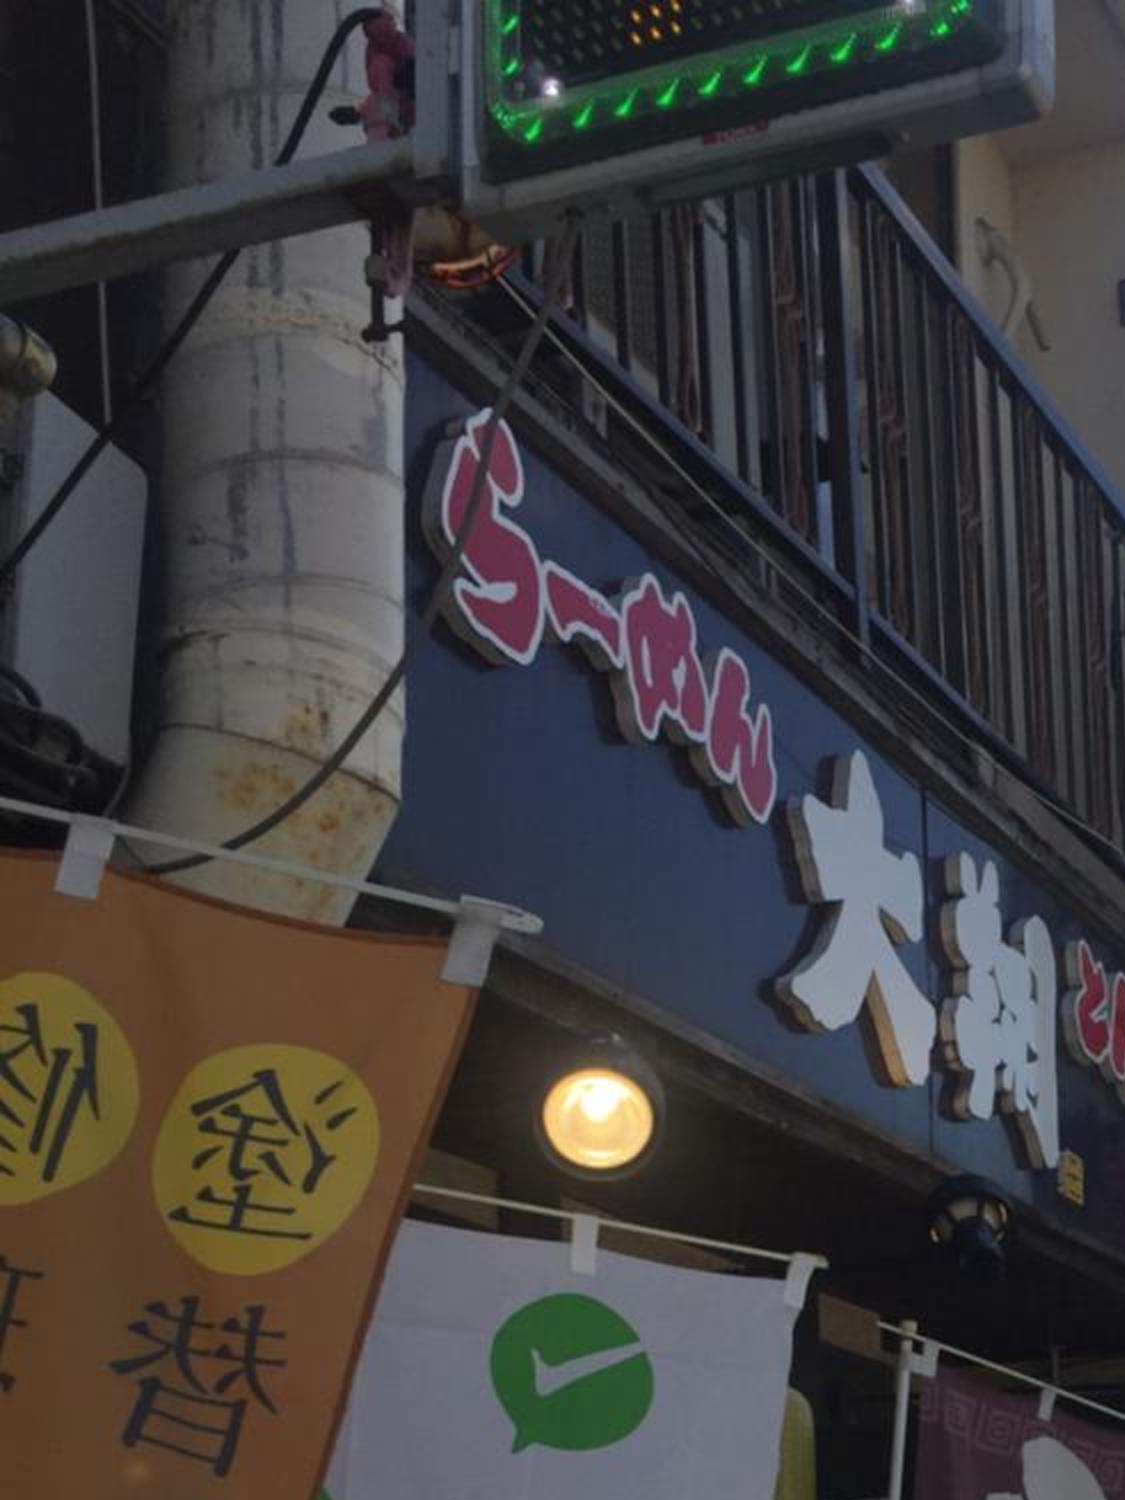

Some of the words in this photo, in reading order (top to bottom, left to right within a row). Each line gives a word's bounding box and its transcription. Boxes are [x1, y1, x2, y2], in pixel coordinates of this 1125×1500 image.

[441, 408, 777, 824] らーめん
[788, 748, 1060, 1170] 大翔
